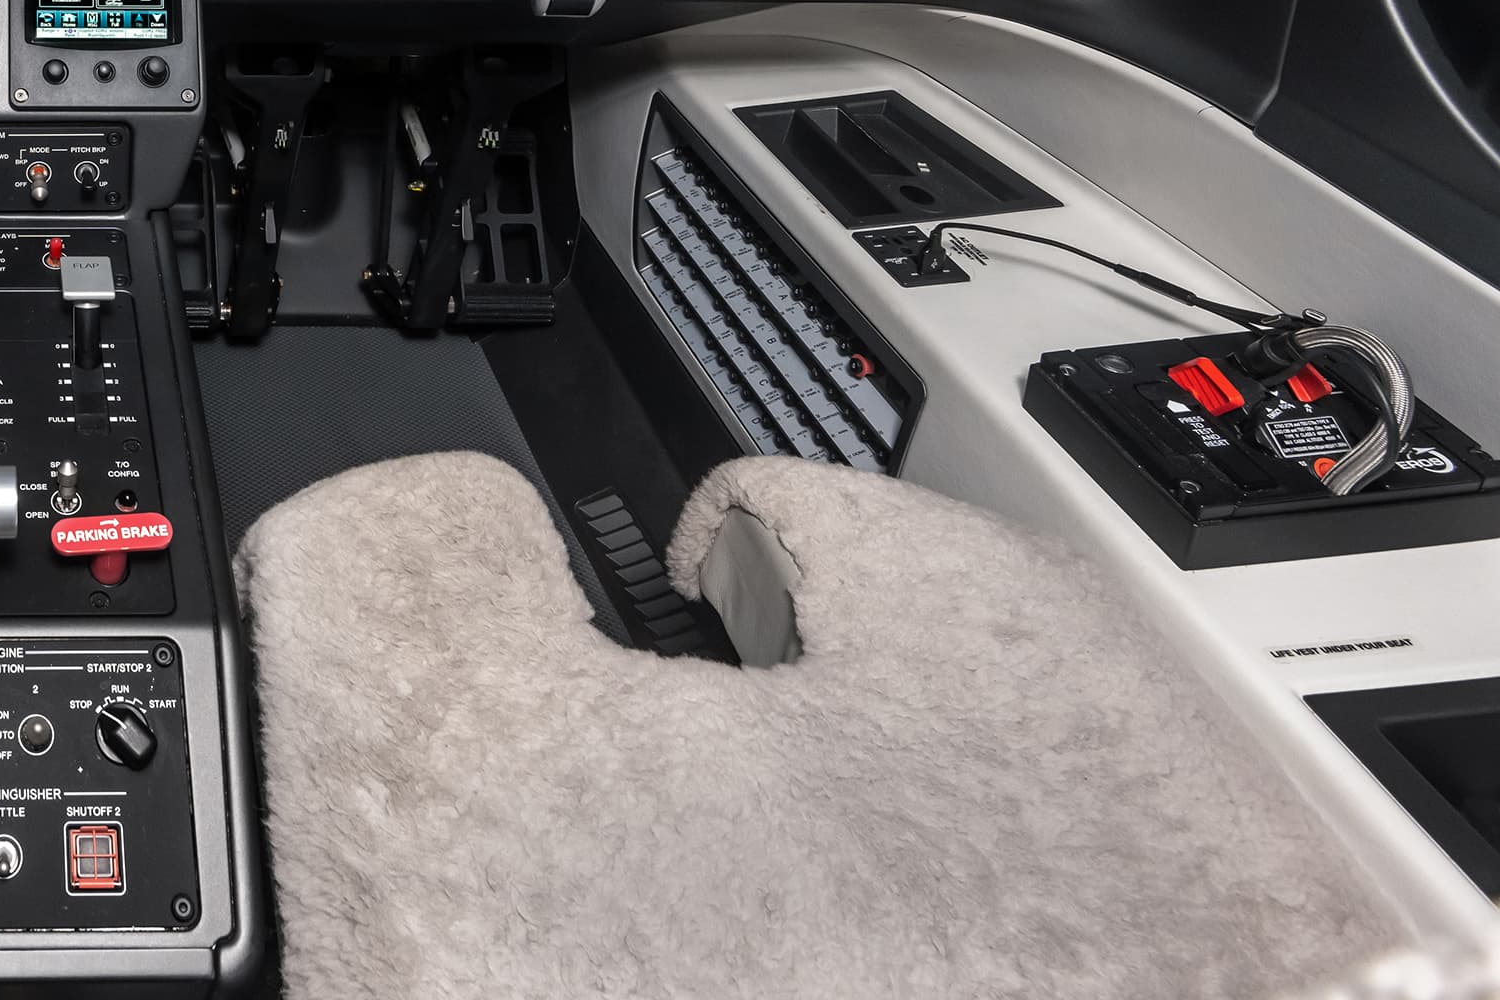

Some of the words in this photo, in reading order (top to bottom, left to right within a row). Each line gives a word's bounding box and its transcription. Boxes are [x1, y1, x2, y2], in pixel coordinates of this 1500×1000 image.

[72, 262, 100, 270] FLAP
[107, 470, 140, 478] CONFIG
[19, 483, 48, 491] CLOSE
[25, 511, 49, 519] OPEN
[56, 527, 118, 544] PARKING
[121, 524, 169, 540] BRAKE
[1269, 650, 1294, 658] LIFE
[1291, 647, 1321, 656] VEST
[1319, 644, 1357, 654] UNDER
[1355, 641, 1387, 650] YOUR
[1384, 638, 1413, 648] SEAT
[86, 662, 145, 674] START/STOP
[145, 662, 152, 673] 2
[32, 685, 39, 694] 2
[111, 684, 130, 694] RUN
[69, 699, 93, 710] STOP
[148, 699, 177, 709] START
[66, 806, 113, 817] SHUTOFF
[114, 806, 121, 817] 2
